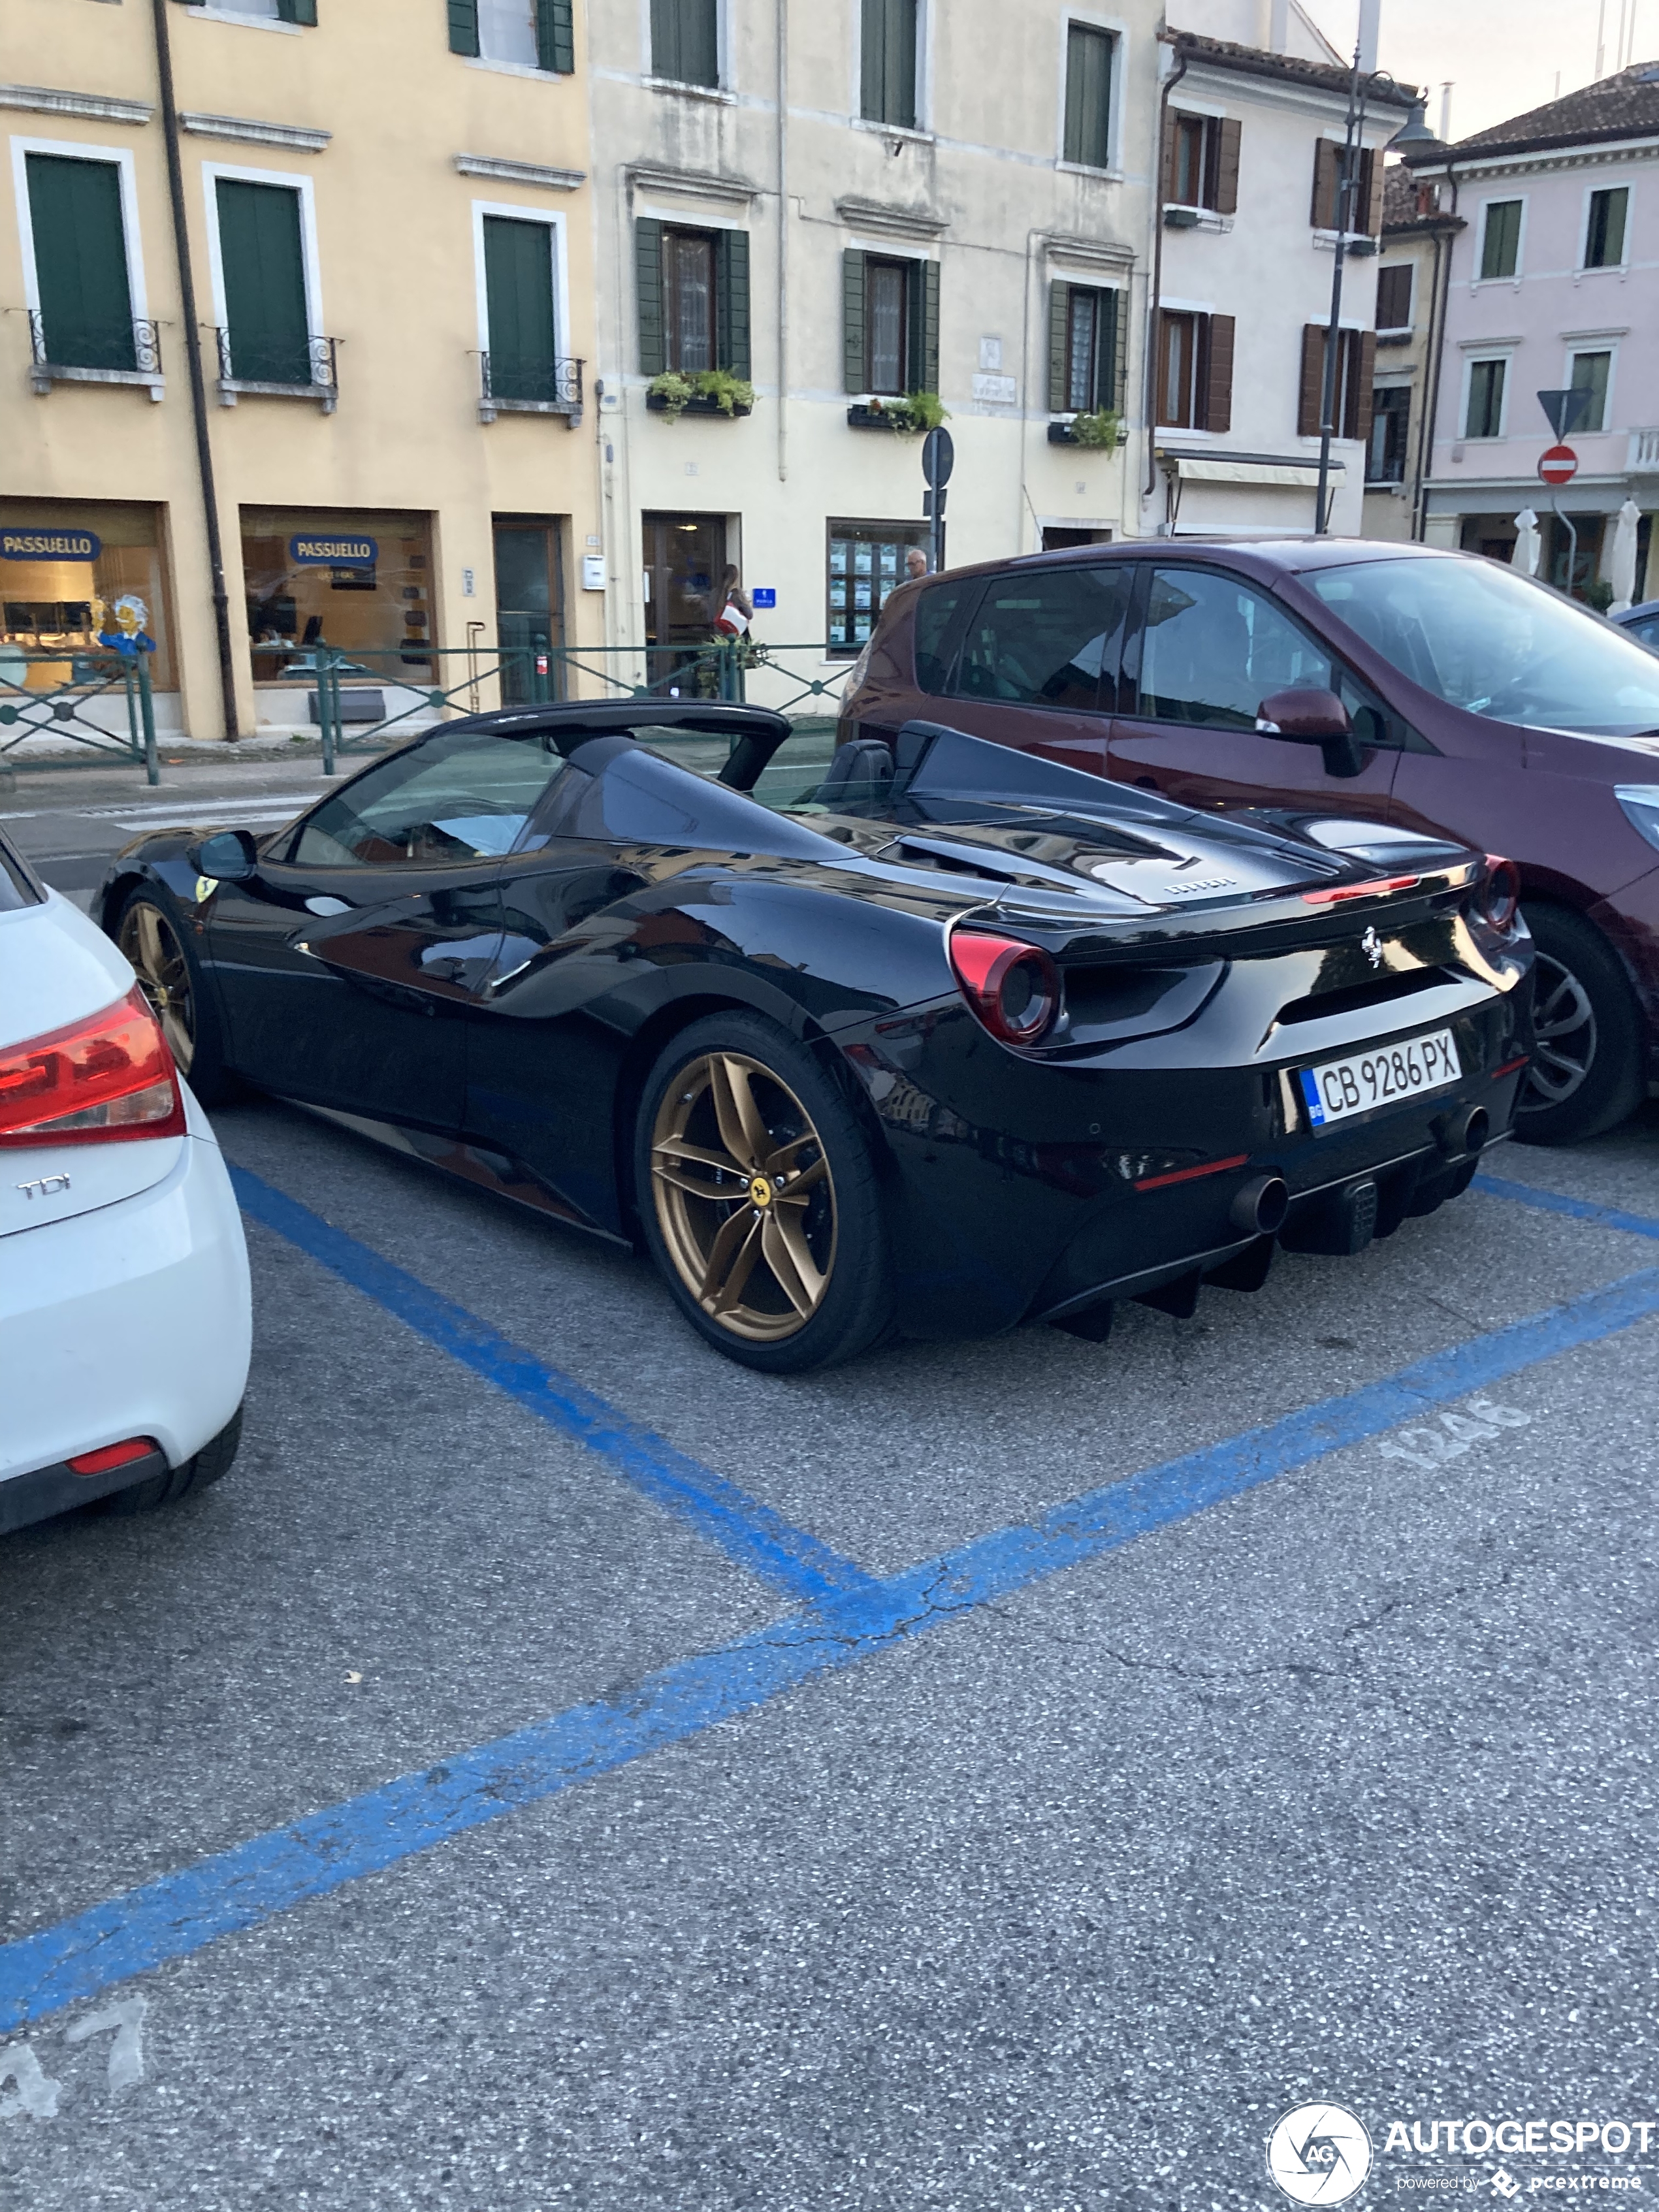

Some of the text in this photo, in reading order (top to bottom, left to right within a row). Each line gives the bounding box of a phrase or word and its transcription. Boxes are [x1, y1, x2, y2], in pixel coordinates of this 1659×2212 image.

[3, 536, 92, 554] PASSUELLO
[297, 542, 370, 558] PASSUELLO
[1322, 1036, 1456, 1112] CB 9286 PX
[1308, 1104, 1323, 1119] BG
[17, 1172, 71, 1200] TDI
